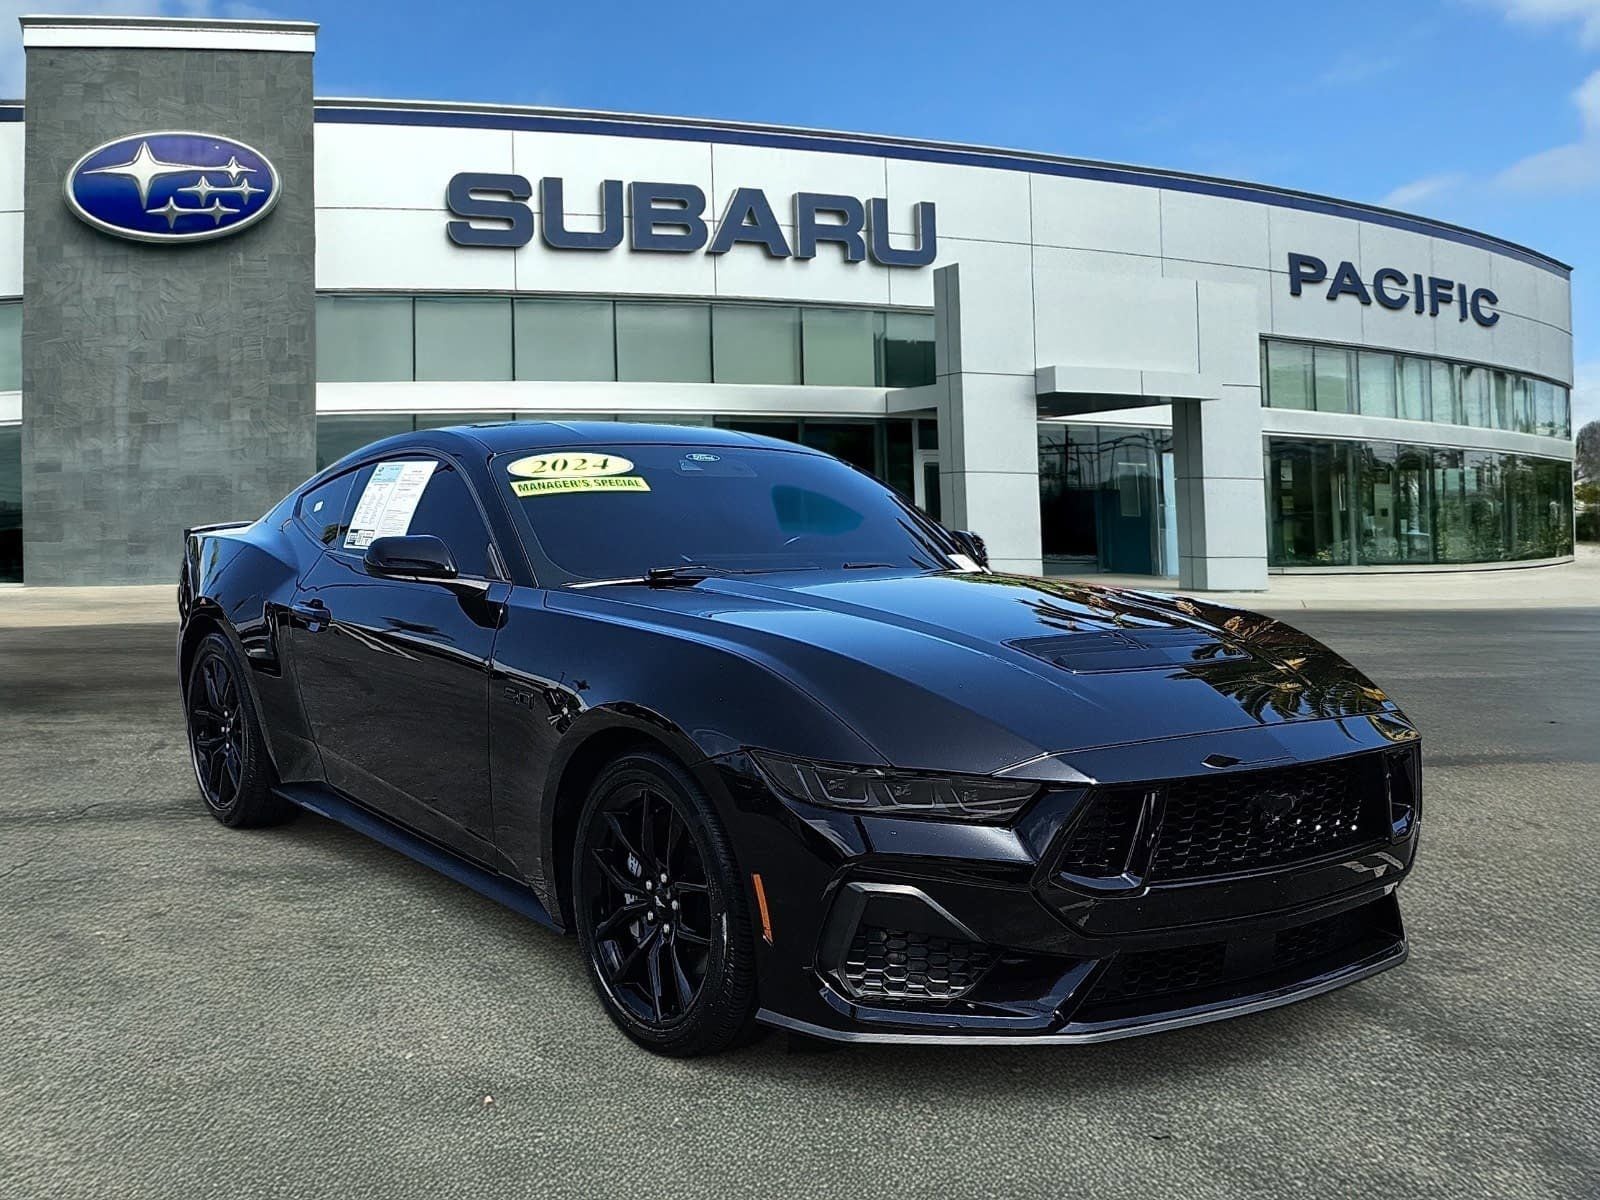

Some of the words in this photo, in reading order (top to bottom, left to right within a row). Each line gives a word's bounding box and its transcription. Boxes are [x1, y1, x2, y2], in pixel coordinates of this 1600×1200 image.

[446, 171, 937, 267] SUBARU
[1287, 252, 1500, 328] PACIFIC
[517, 479, 590, 492] MANAGER'S
[594, 478, 642, 488] SPECIAL
[531, 457, 609, 474] 2024
